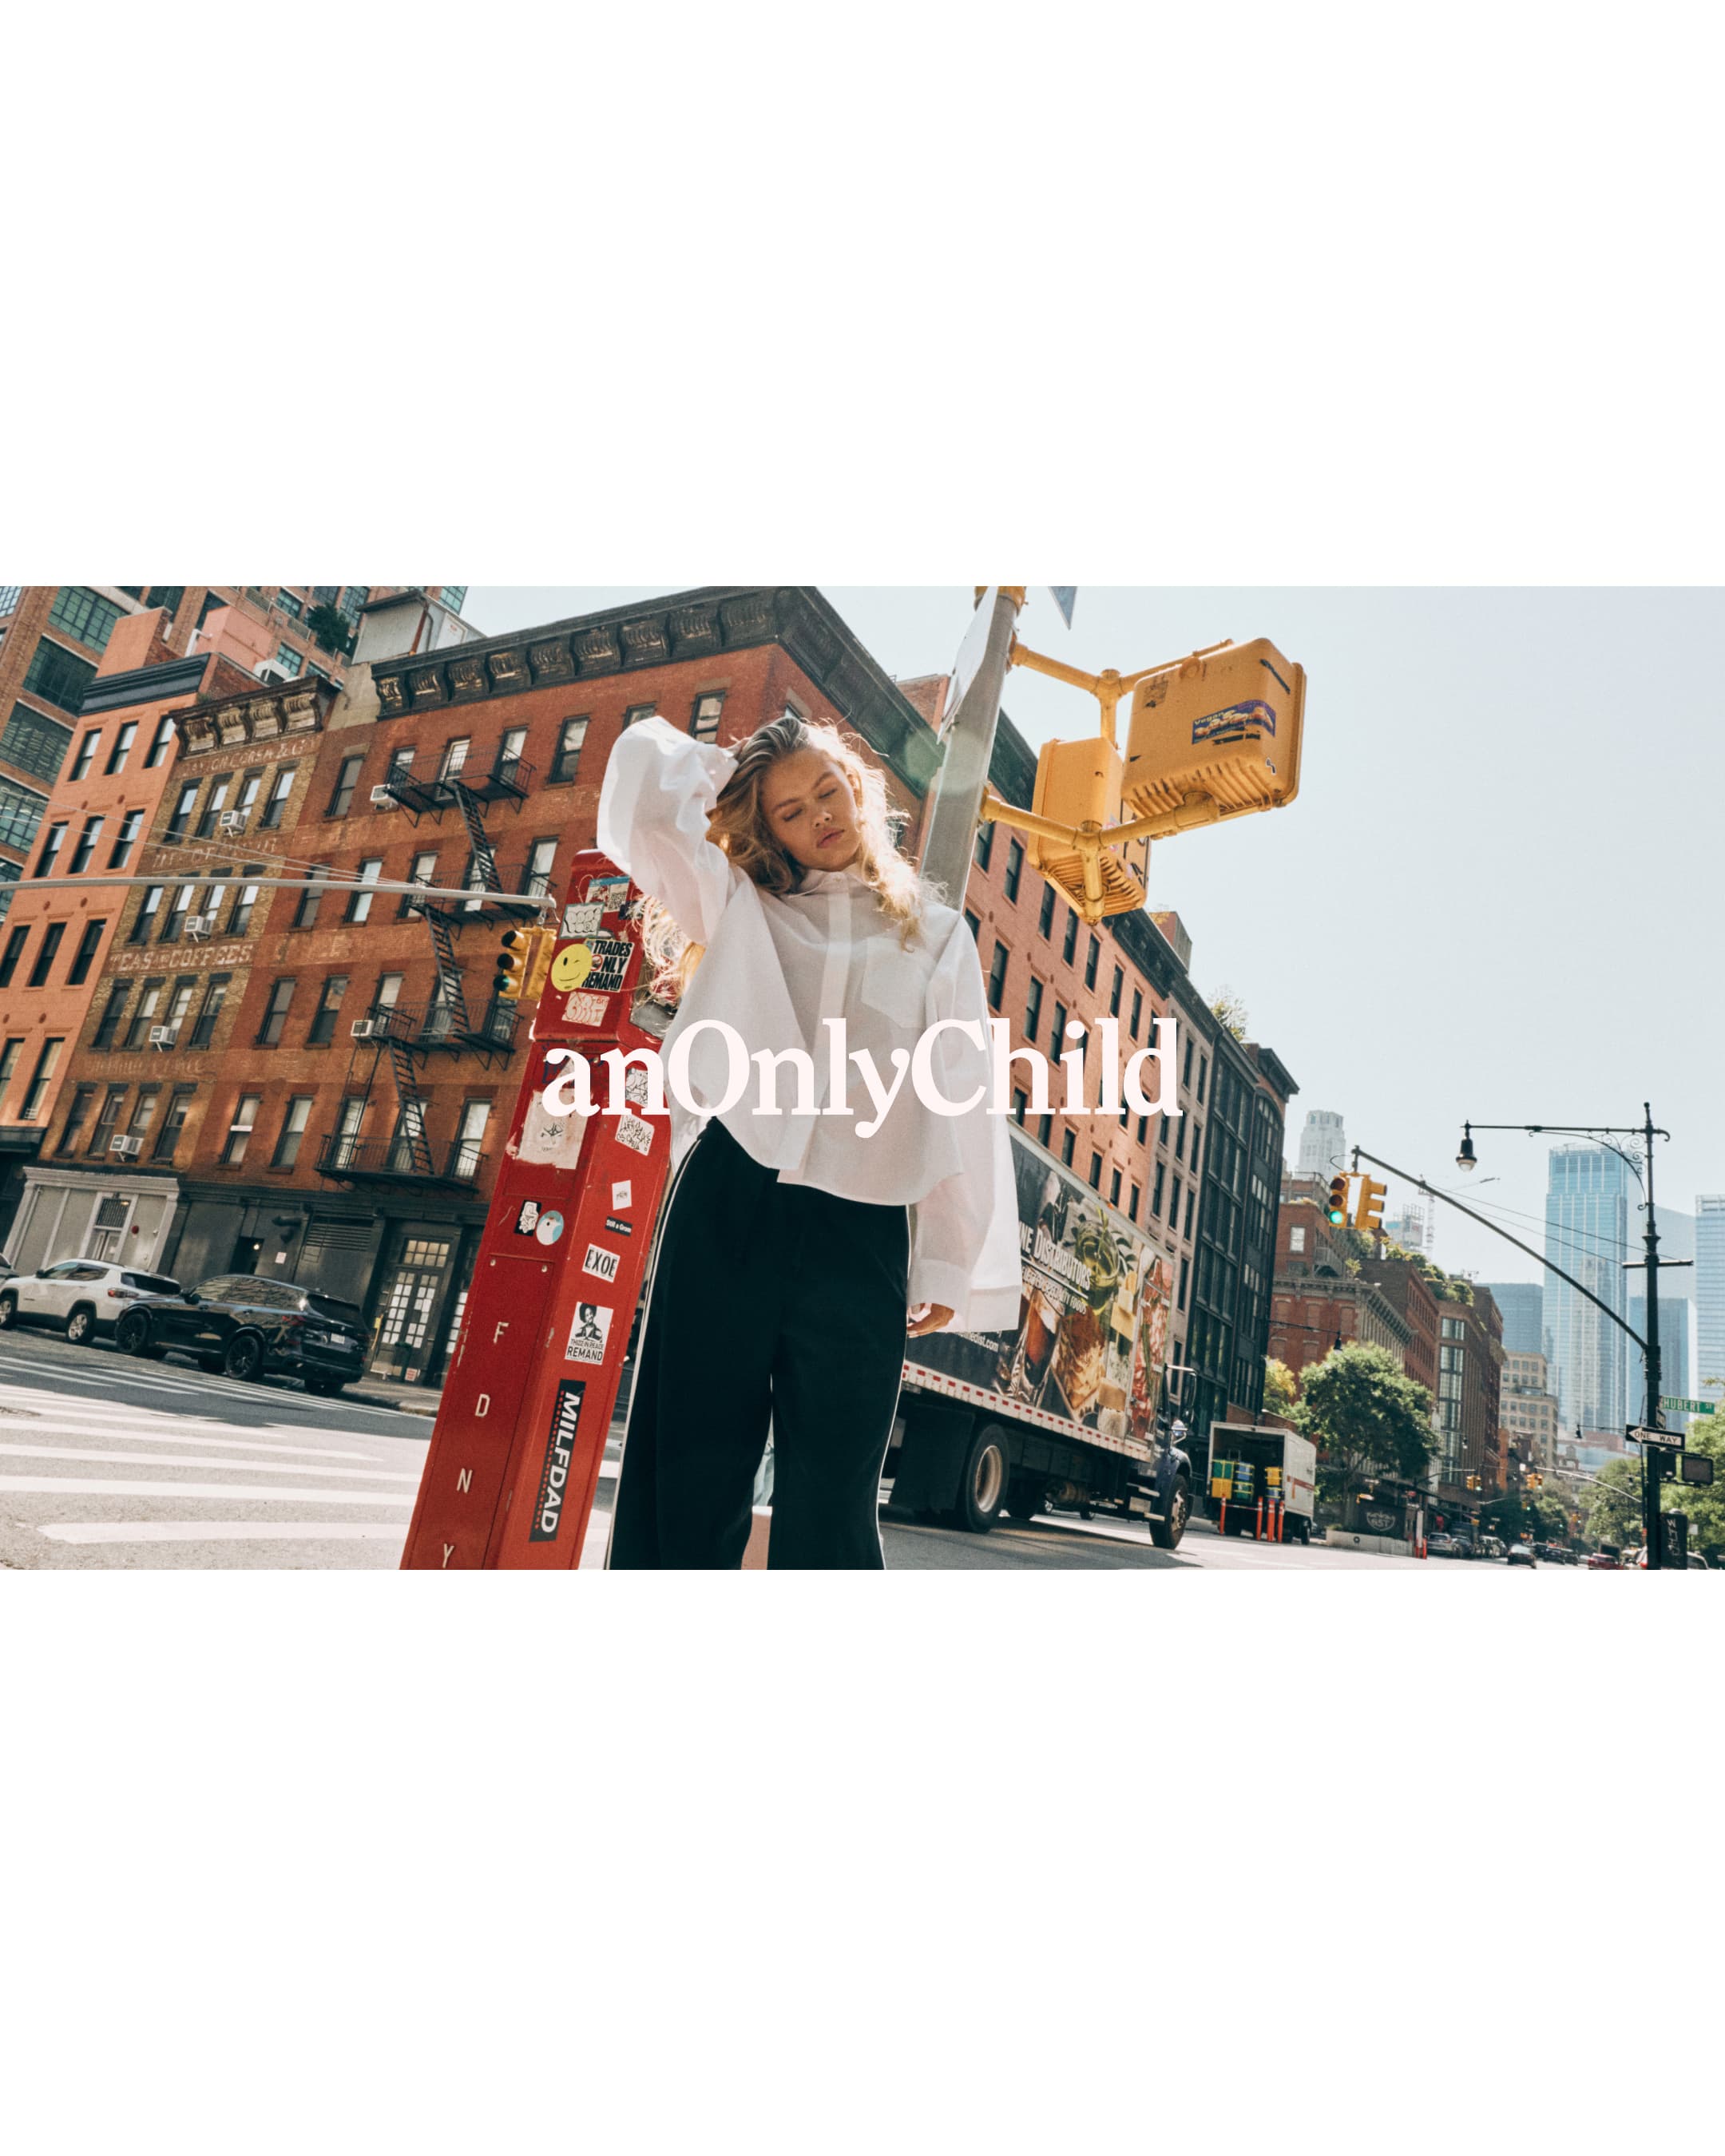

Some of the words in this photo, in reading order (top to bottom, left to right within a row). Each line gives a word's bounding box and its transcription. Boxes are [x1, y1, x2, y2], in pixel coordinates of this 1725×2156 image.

[593, 940, 632, 957] TRADES
[109, 951, 153, 972] TEAS
[169, 945, 253, 968] COFFEES
[585, 1249, 617, 1278] EXOE
[567, 1346, 603, 1361] REMAND
[1664, 1397, 1701, 1413] HUBERT
[1634, 1431, 1651, 1441] ONE
[1660, 1435, 1678, 1444] WAY
[541, 1392, 581, 1533] MILFDAD
